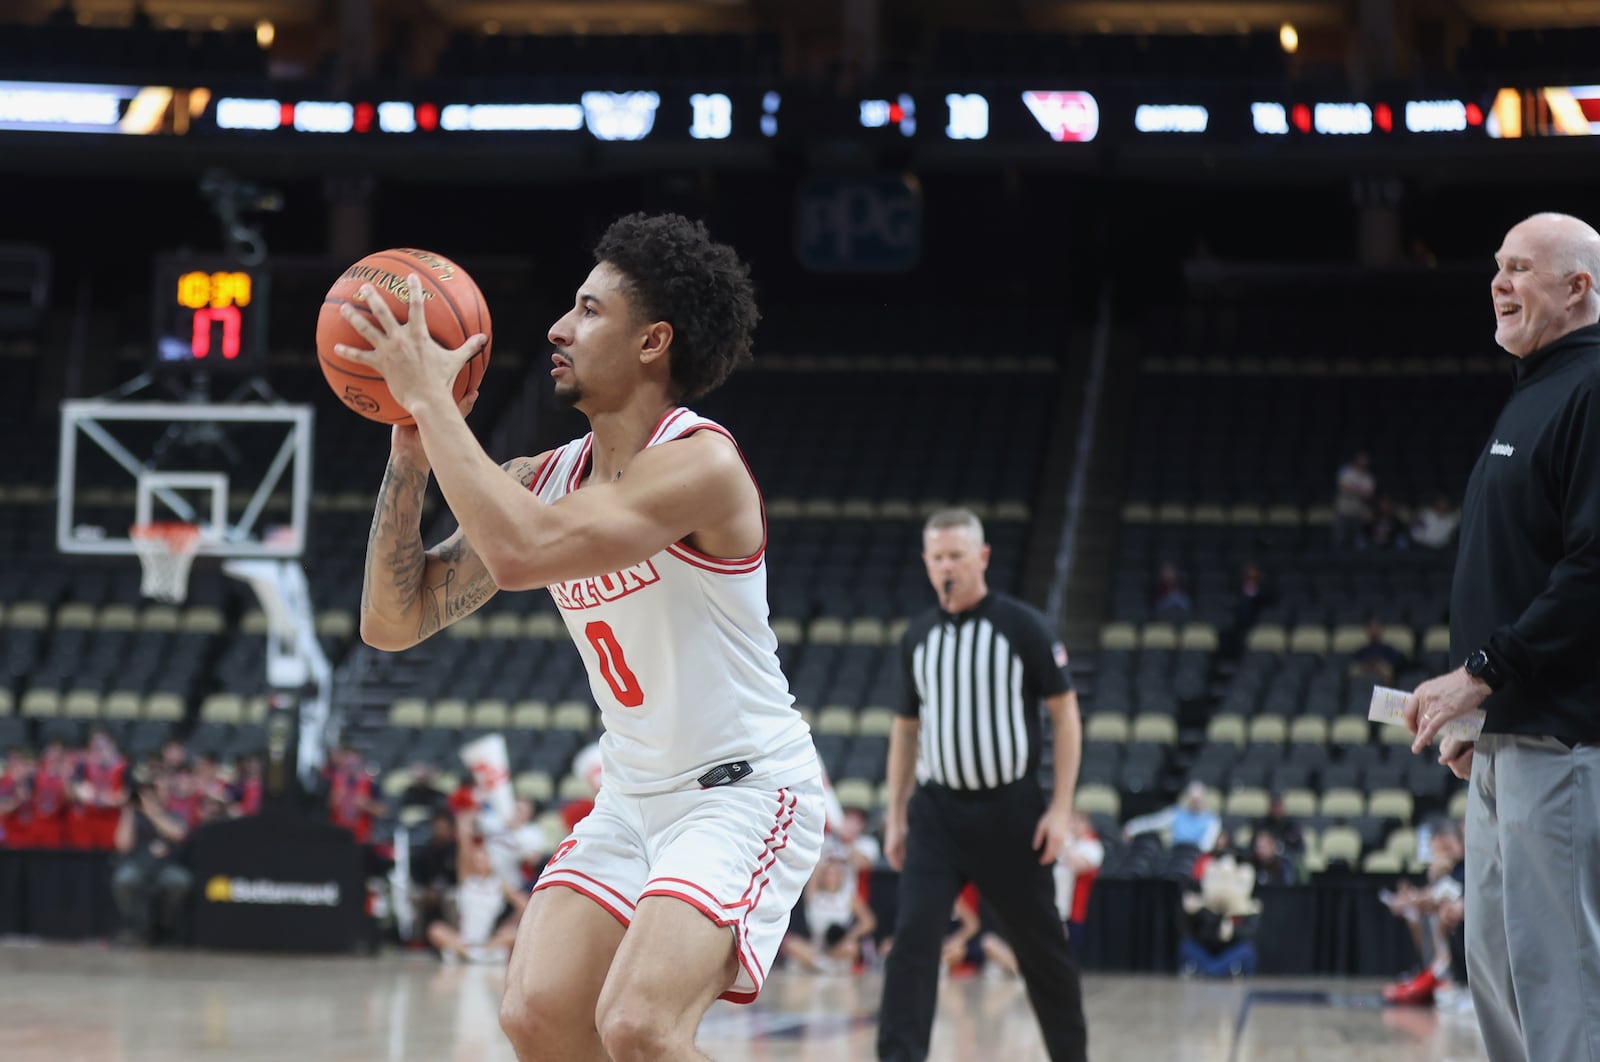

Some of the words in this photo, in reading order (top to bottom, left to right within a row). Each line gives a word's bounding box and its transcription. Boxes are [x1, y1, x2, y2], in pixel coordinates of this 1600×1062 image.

[335, 265, 435, 304] PALDIN
[585, 620, 645, 708] 0
[732, 763, 741, 772] S
